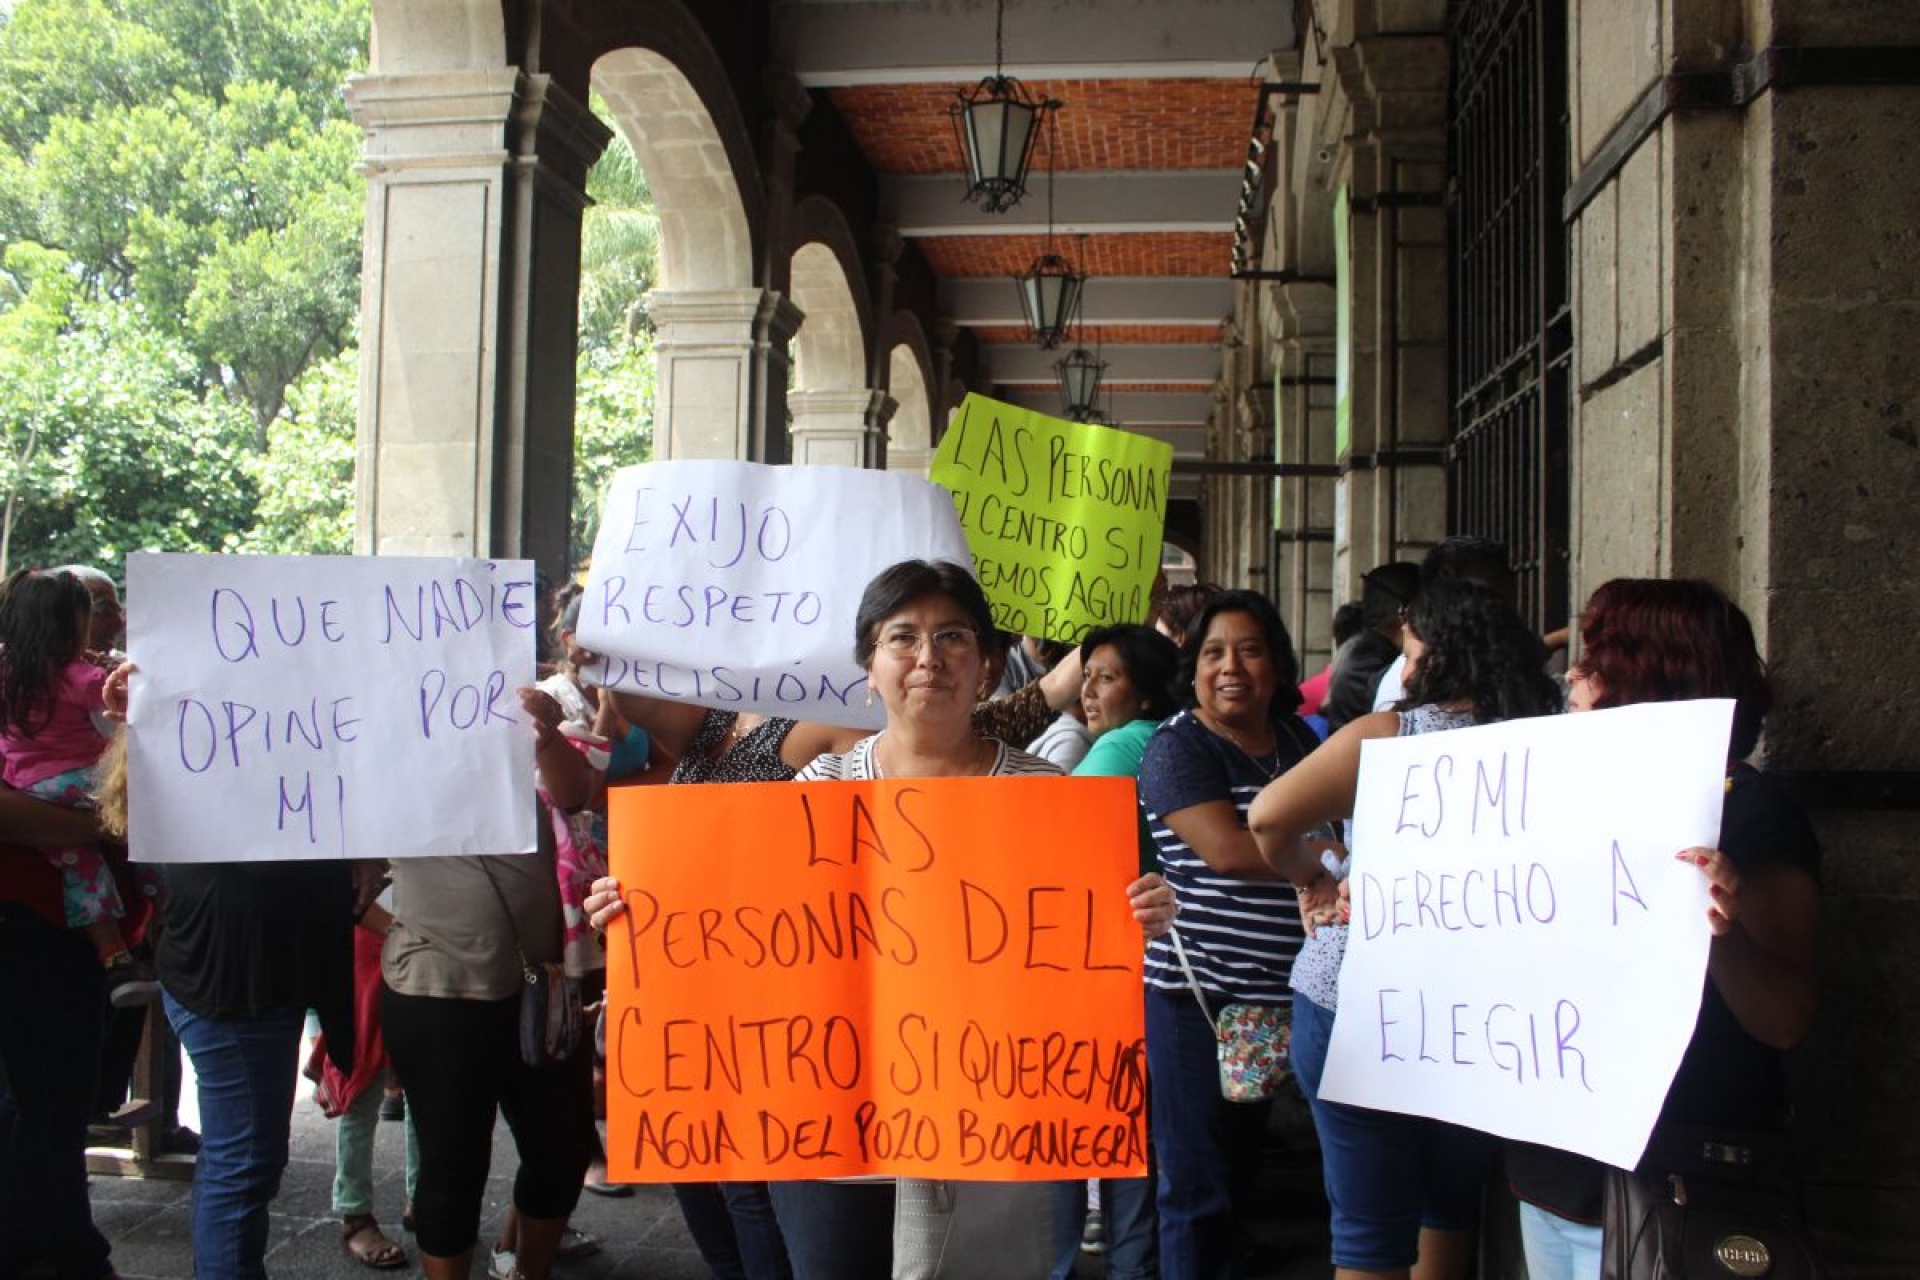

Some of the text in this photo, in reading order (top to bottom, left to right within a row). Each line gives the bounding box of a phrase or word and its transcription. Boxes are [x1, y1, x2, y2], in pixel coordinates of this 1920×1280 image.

[953, 402, 1034, 497] LAS
[625, 487, 791, 569] EXIJO
[979, 493, 1089, 561] CENTRO
[1105, 527, 1144, 571] SI
[212, 588, 345, 662] QUE
[602, 576, 822, 627] RESPETO
[1064, 571, 1142, 624] AGUA
[178, 669, 518, 773] OPINE POR
[602, 655, 869, 706] DECISIÓN
[277, 771, 346, 858] MI
[801, 788, 936, 872] LAS
[1395, 746, 1531, 838] ES MI
[1362, 838, 1649, 941] DERECHO A
[622, 879, 1133, 989] PERSONAS DEL
[617, 1006, 1146, 1117] CENTRO SI QUEREMOS
[1378, 988, 1594, 1093] ELEGIR
[634, 1101, 1145, 1170] AGUA DEL POZO BOCANEGRA
